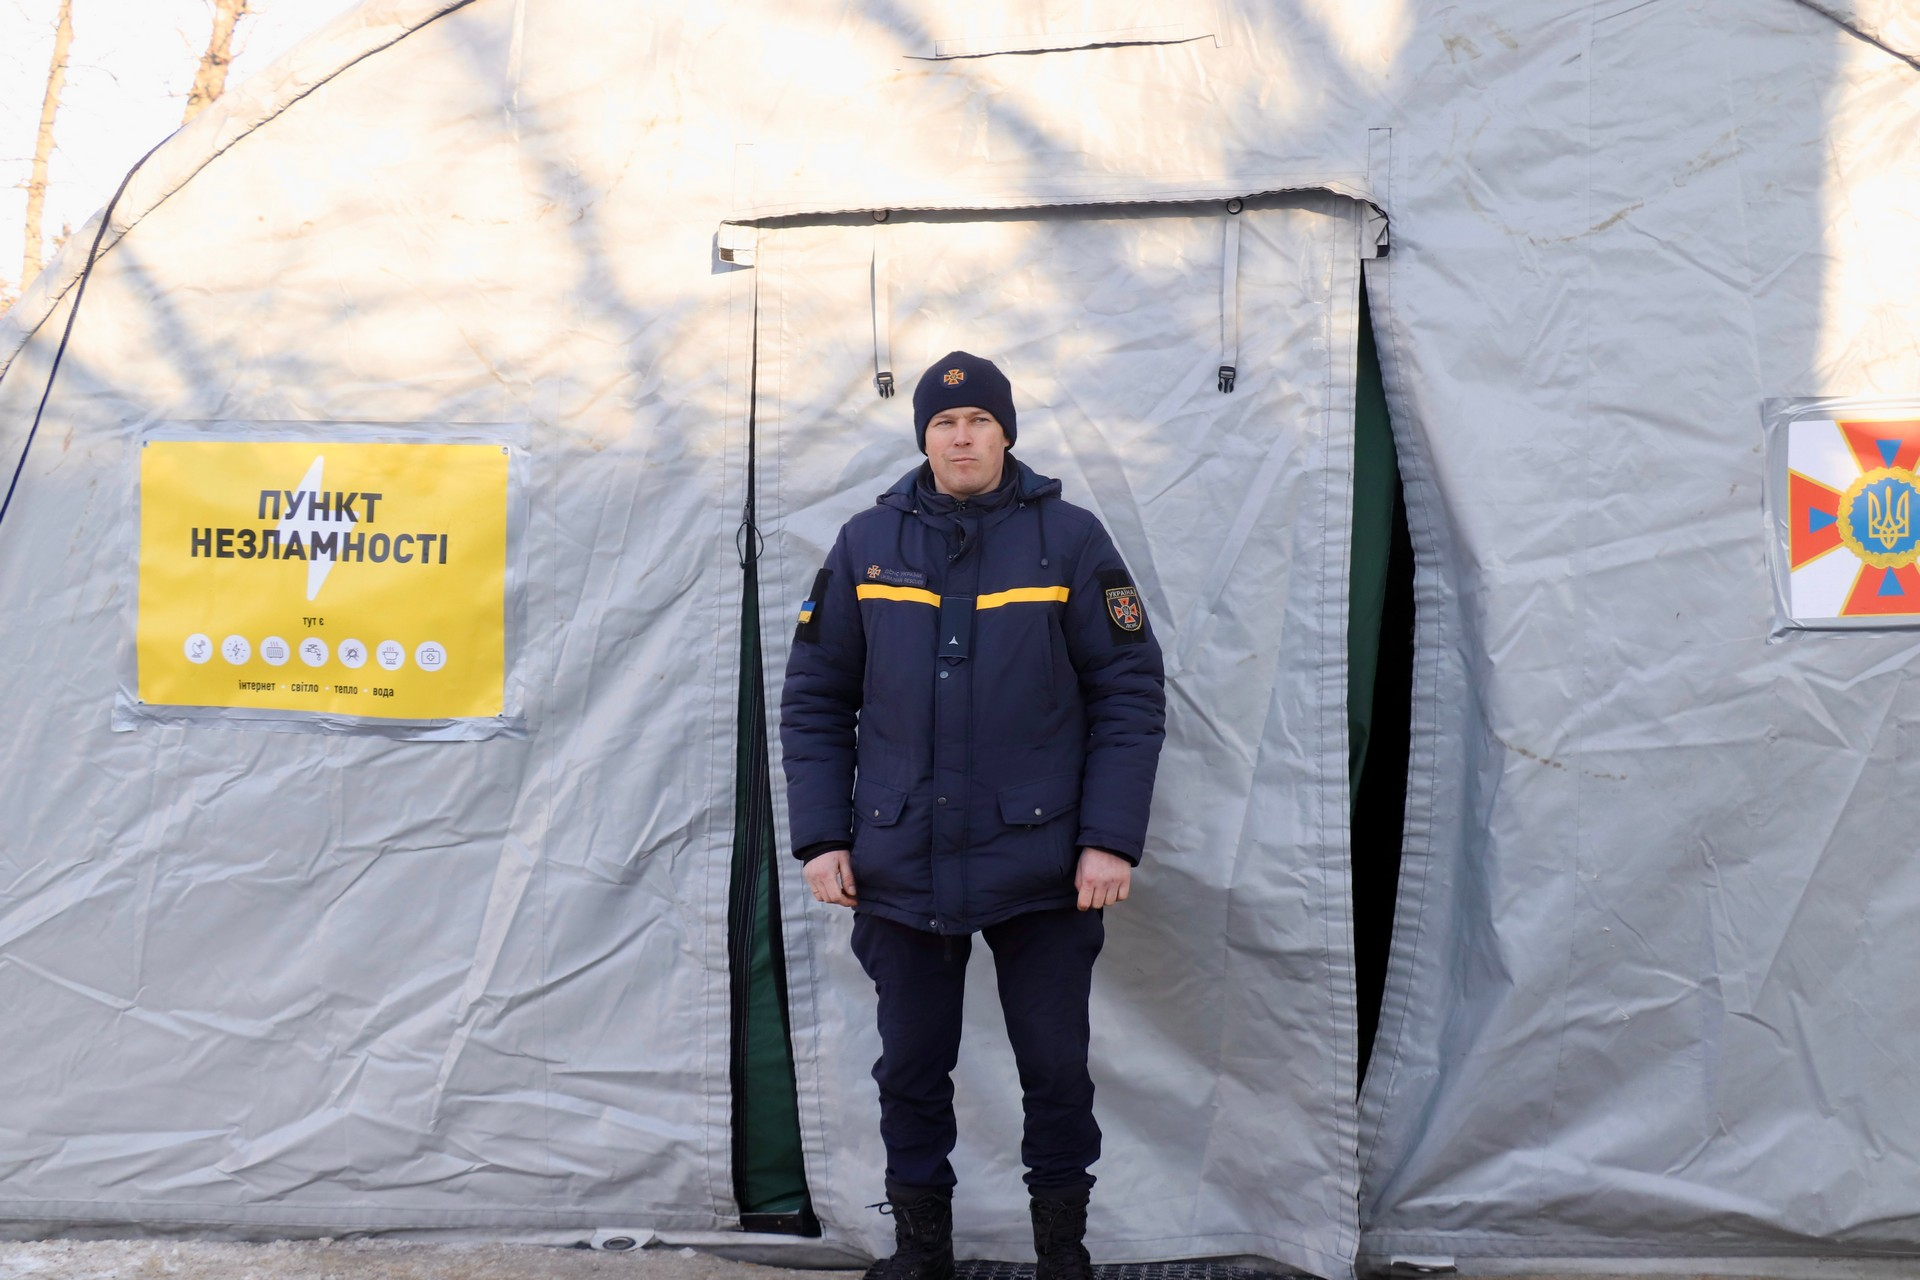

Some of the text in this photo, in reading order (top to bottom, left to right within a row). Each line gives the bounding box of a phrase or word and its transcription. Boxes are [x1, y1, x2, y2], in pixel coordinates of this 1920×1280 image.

[258, 490, 382, 523] ПУНКТ
[191, 527, 448, 564] НЕЗЛАМНОСТІ
[1108, 589, 1134, 598] УКРАЇНА
[302, 616, 317, 628] тут
[238, 679, 394, 698] інтернет світло тепло вода
